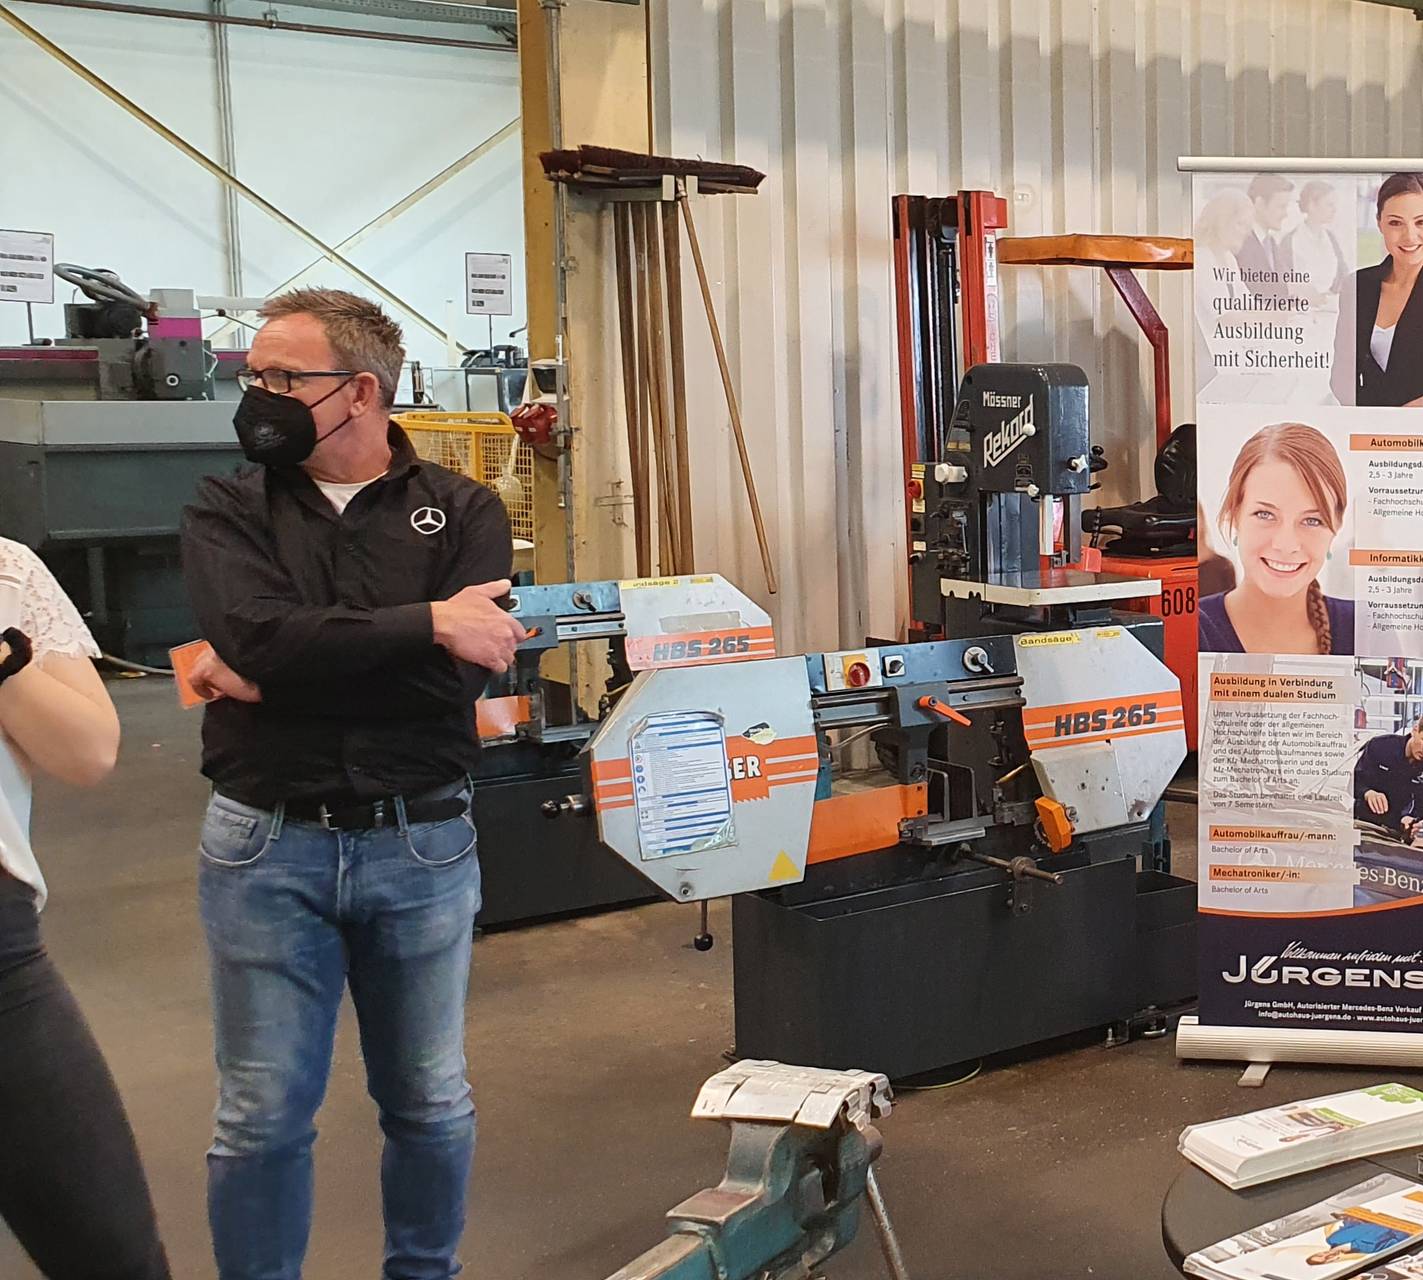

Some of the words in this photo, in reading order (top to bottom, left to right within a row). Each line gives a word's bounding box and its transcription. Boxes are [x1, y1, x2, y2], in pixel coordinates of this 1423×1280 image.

[1213, 267, 1236, 282] Wir
[1240, 268, 1279, 283] bieten
[1283, 269, 1310, 283] eine
[1213, 293, 1309, 315] qualifizierte
[1213, 322, 1304, 345] Ausbildung
[1214, 350, 1239, 367] mit
[1245, 350, 1329, 369] Sicherheit!
[983, 391, 1021, 408] Mössner
[984, 393, 1033, 468] Rekord
[1368, 471, 1380, 479] 2,5
[1373, 508, 1413, 518] Allgemeine
[1368, 586, 1380, 594] 2,5
[1393, 586, 1412, 594] Jahre
[1162, 586, 1195, 617] 608
[1372, 623, 1412, 632] Allgemeine
[654, 639, 702, 661] HBS
[708, 635, 750, 655] 265
[1213, 677, 1266, 688] Ausbildung
[1268, 678, 1277, 686] in
[1279, 678, 1333, 689] Verbindung
[1213, 690, 1229, 698] mit
[1232, 690, 1260, 698] einem
[1263, 690, 1294, 699] dualen
[1297, 691, 1336, 699] Studium
[1055, 709, 1107, 737] HBS
[1112, 702, 1157, 729] 265
[1213, 829, 1336, 841] Automobilkauffrau/-mann:
[1253, 846, 1268, 854] Arts
[1213, 868, 1300, 880] Mechatroniker/-in:
[1211, 885, 1242, 893] Bachelor
[1244, 885, 1252, 893] of
[1253, 886, 1268, 894] Arts
[1244, 1000, 1270, 1009] Jürgens
[1272, 1001, 1295, 1010] GmbH,
[1297, 1002, 1341, 1010] Autorisierter
[1342, 1003, 1394, 1012] Mercedes-Benz
[1395, 1005, 1422, 1013] Verkauf
